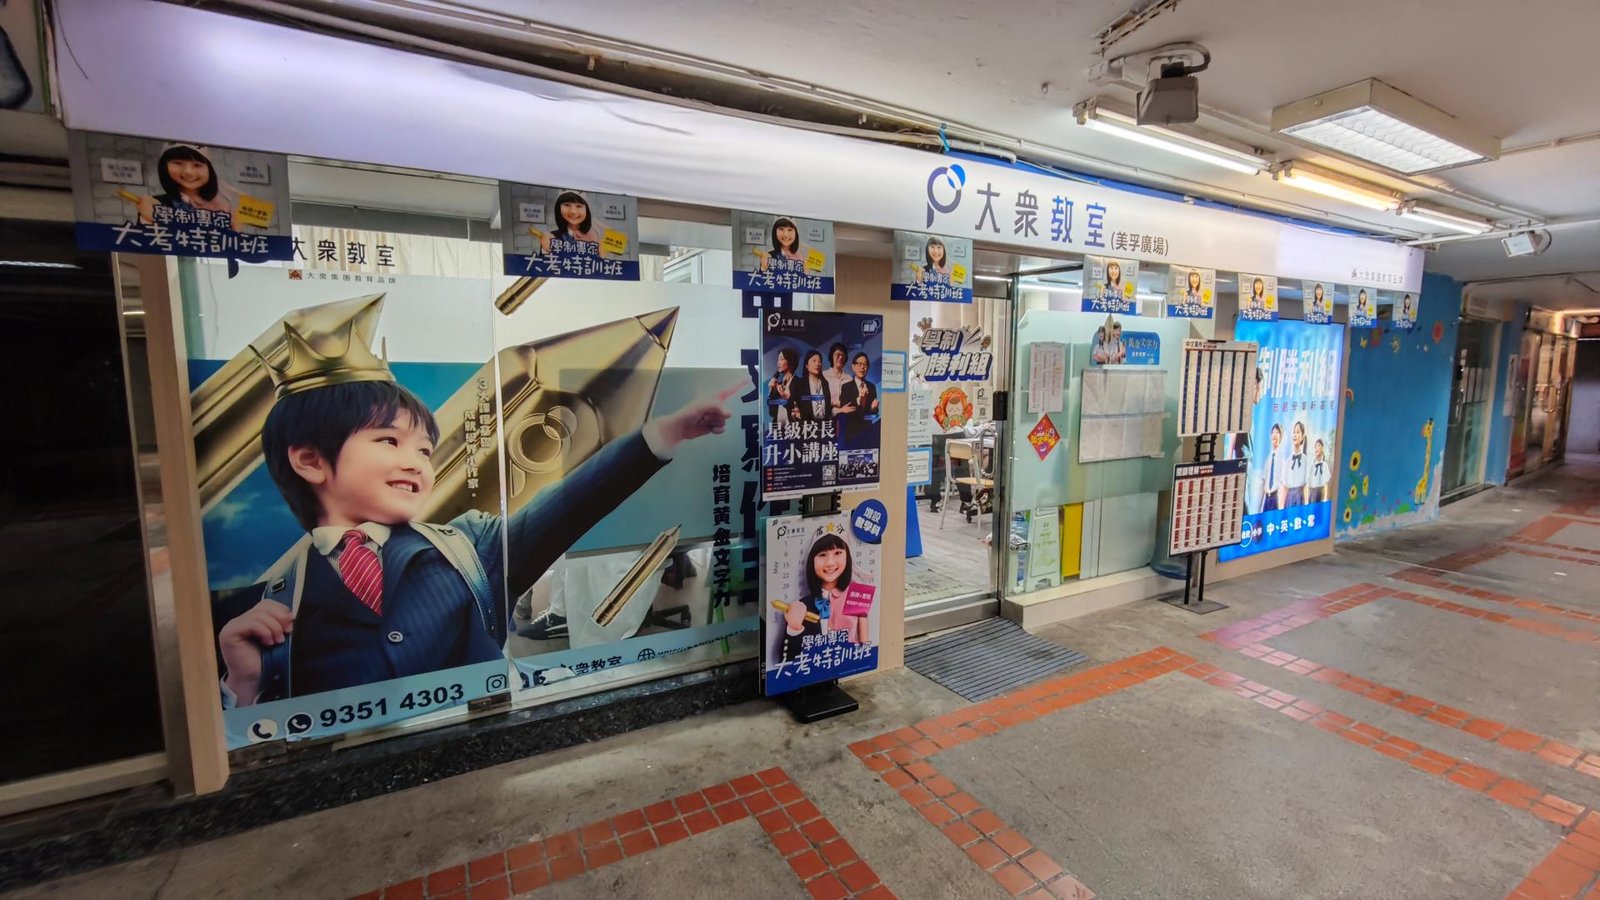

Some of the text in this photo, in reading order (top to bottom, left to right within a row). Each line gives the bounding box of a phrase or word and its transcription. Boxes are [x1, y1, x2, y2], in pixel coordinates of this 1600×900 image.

[152, 205, 232, 229] 學制專家
[112, 222, 270, 254] 大考特訓班
[549, 239, 600, 256] 學制專家
[1110, 230, 1170, 256] (美孚廣場)
[523, 253, 624, 277] 大考特訓班
[747, 270, 822, 290] 大考特訓班
[905, 283, 964, 300] 大考特訓班
[920, 329, 963, 354] 學制
[924, 351, 992, 381] 勝利組
[766, 420, 836, 441] 星級校長
[763, 441, 839, 466] 升小講座
[712, 463, 731, 609] 培育黃金文字力
[801, 629, 849, 651] 學制專家
[775, 642, 872, 679] 大考特訓班
[319, 683, 465, 729] 9351 4303
